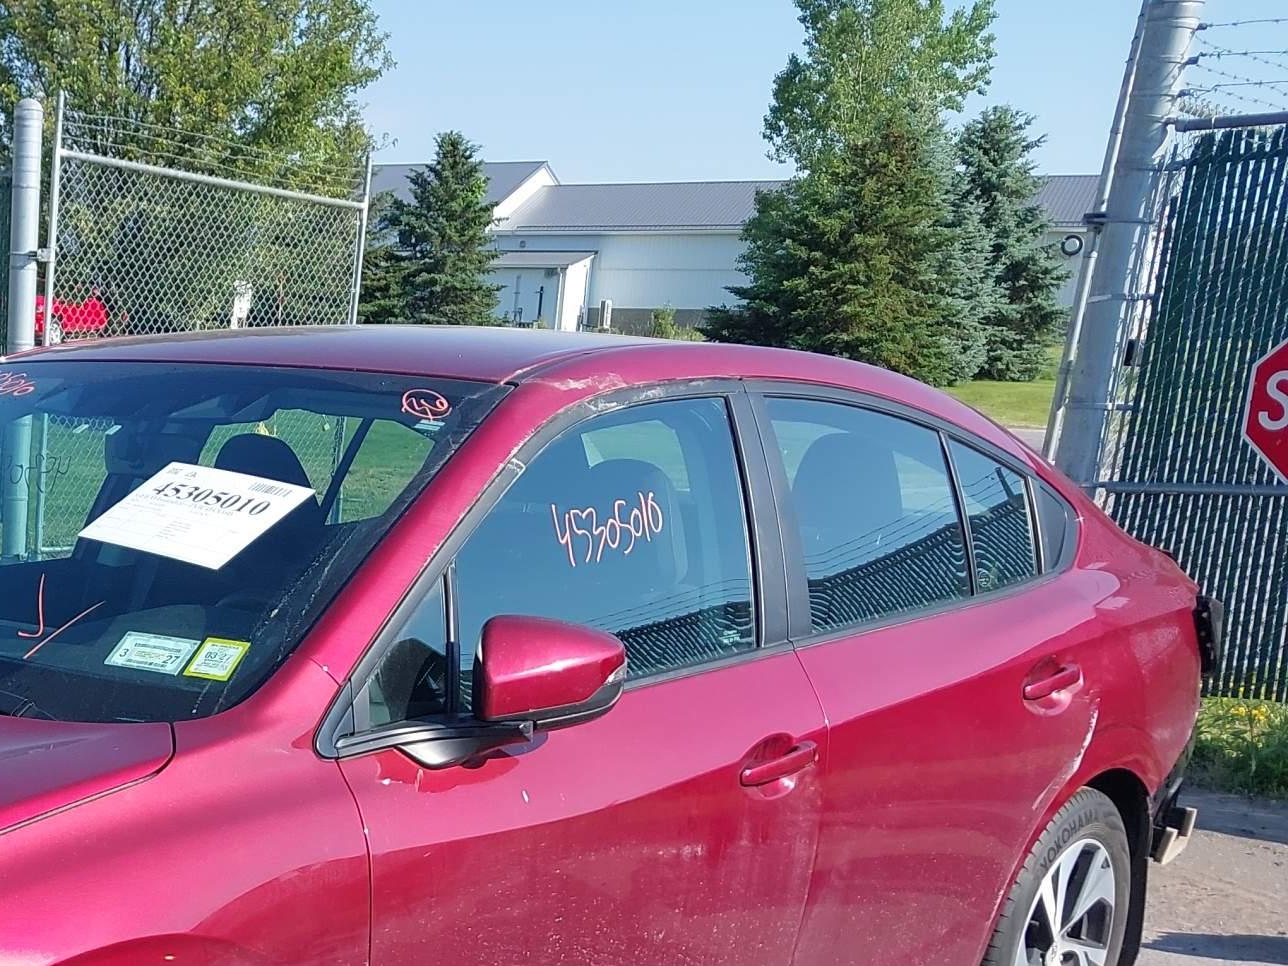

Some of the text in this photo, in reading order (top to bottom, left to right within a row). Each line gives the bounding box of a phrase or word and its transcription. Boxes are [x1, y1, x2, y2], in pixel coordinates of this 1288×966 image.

[152, 481, 272, 516] 45305010
[551, 491, 663, 568] 45305010
[119, 648, 129, 657] 3
[161, 654, 181, 665] 27
